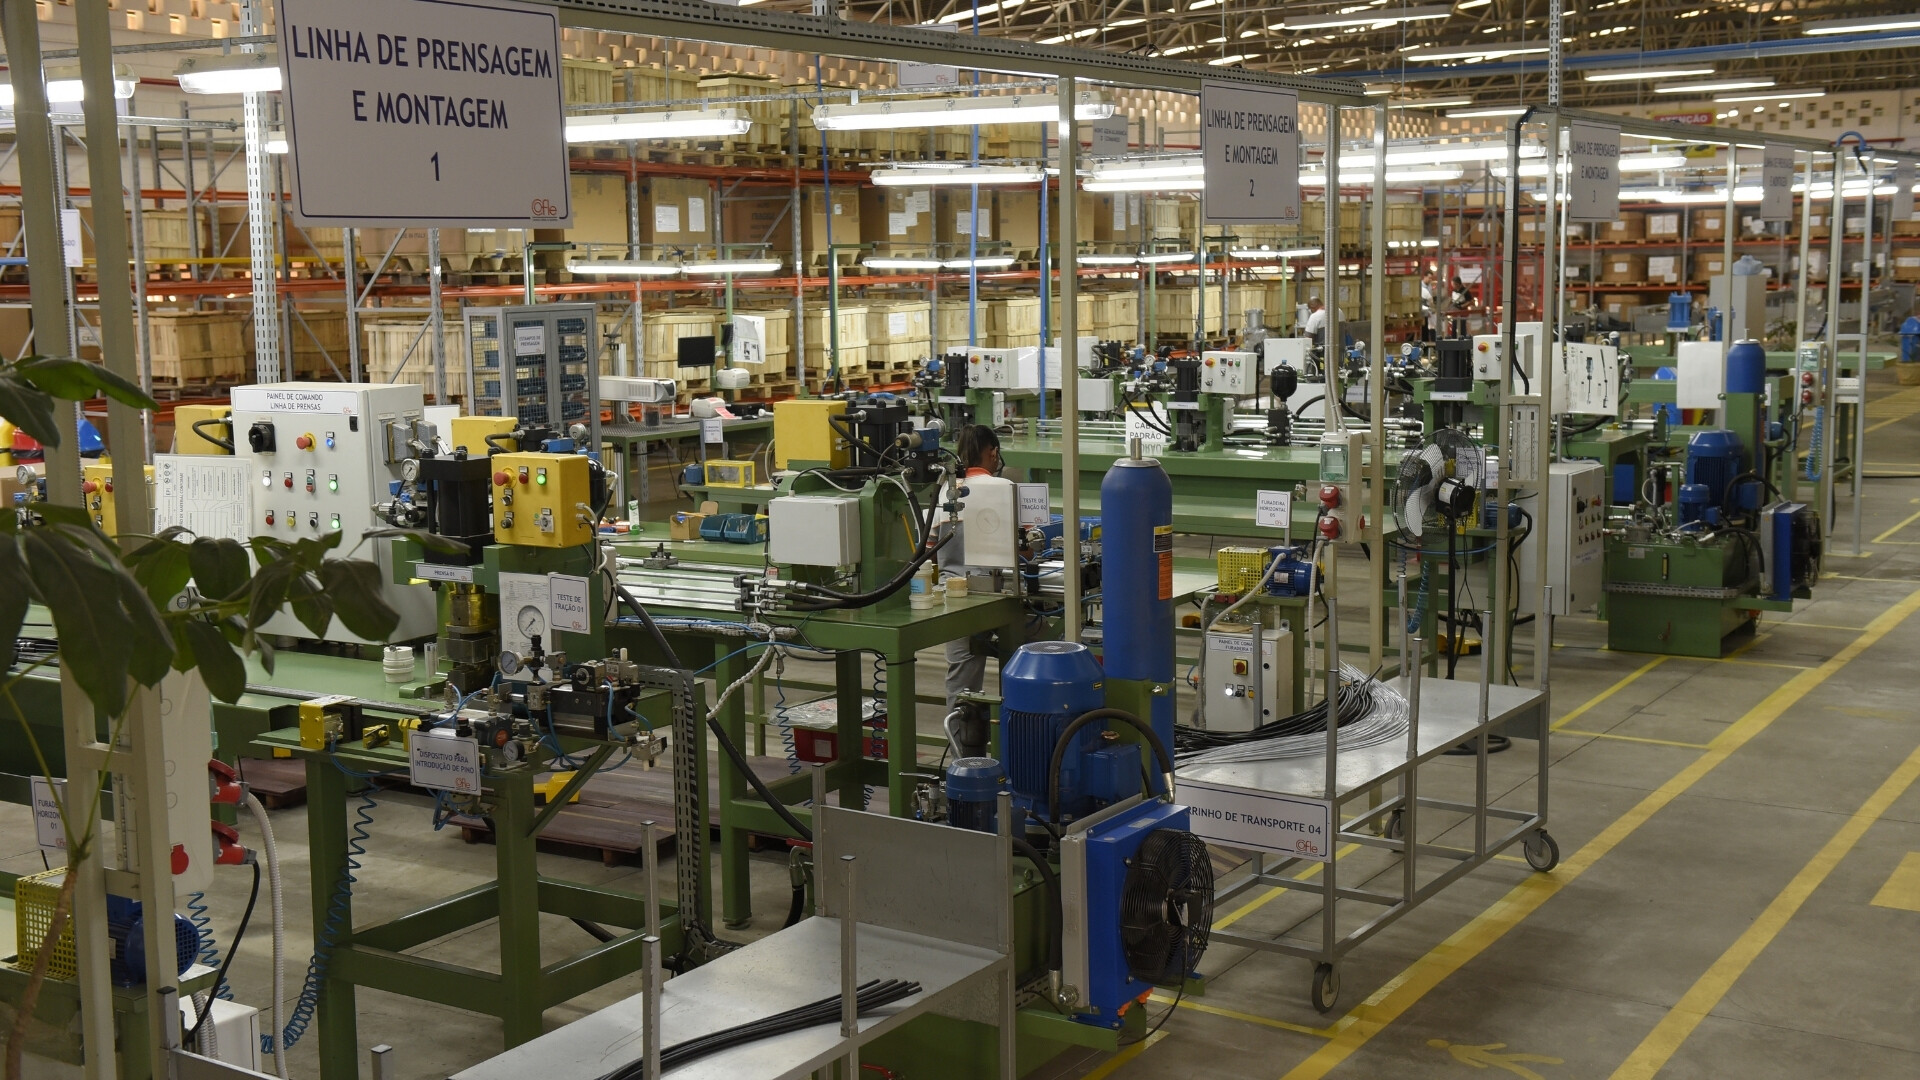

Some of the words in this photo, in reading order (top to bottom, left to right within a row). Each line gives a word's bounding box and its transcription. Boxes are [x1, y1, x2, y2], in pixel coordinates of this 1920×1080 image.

[292, 25, 370, 64] LINHA
[377, 34, 408, 67] DE
[417, 37, 552, 78] PRENSAGEM
[352, 90, 367, 121] E
[377, 92, 508, 129] MONTAGEM
[1207, 108, 1232, 129] LINHA
[1235, 111, 1245, 130] DE
[1248, 112, 1295, 134] PRENSAGEM
[1225, 144, 1230, 162] E
[1233, 145, 1278, 165] MONTAGEM
[431, 152, 440, 181] 1
[1249, 179, 1254, 197] 2
[267, 392, 285, 400] PAINEL
[295, 393, 323, 401] COMANDO
[270, 402, 287, 410] LINHA
[555, 603, 576, 612] TRAÇÃO
[420, 751, 453, 761] DISPOSITIVO
[454, 754, 469, 763] PARA
[415, 760, 451, 771] INTRODUÇÃO
[461, 766, 474, 774] PINO
[1225, 811, 1237, 822] DE
[1241, 814, 1305, 833] TRANSPORTE
[1308, 824, 1322, 835] 04
